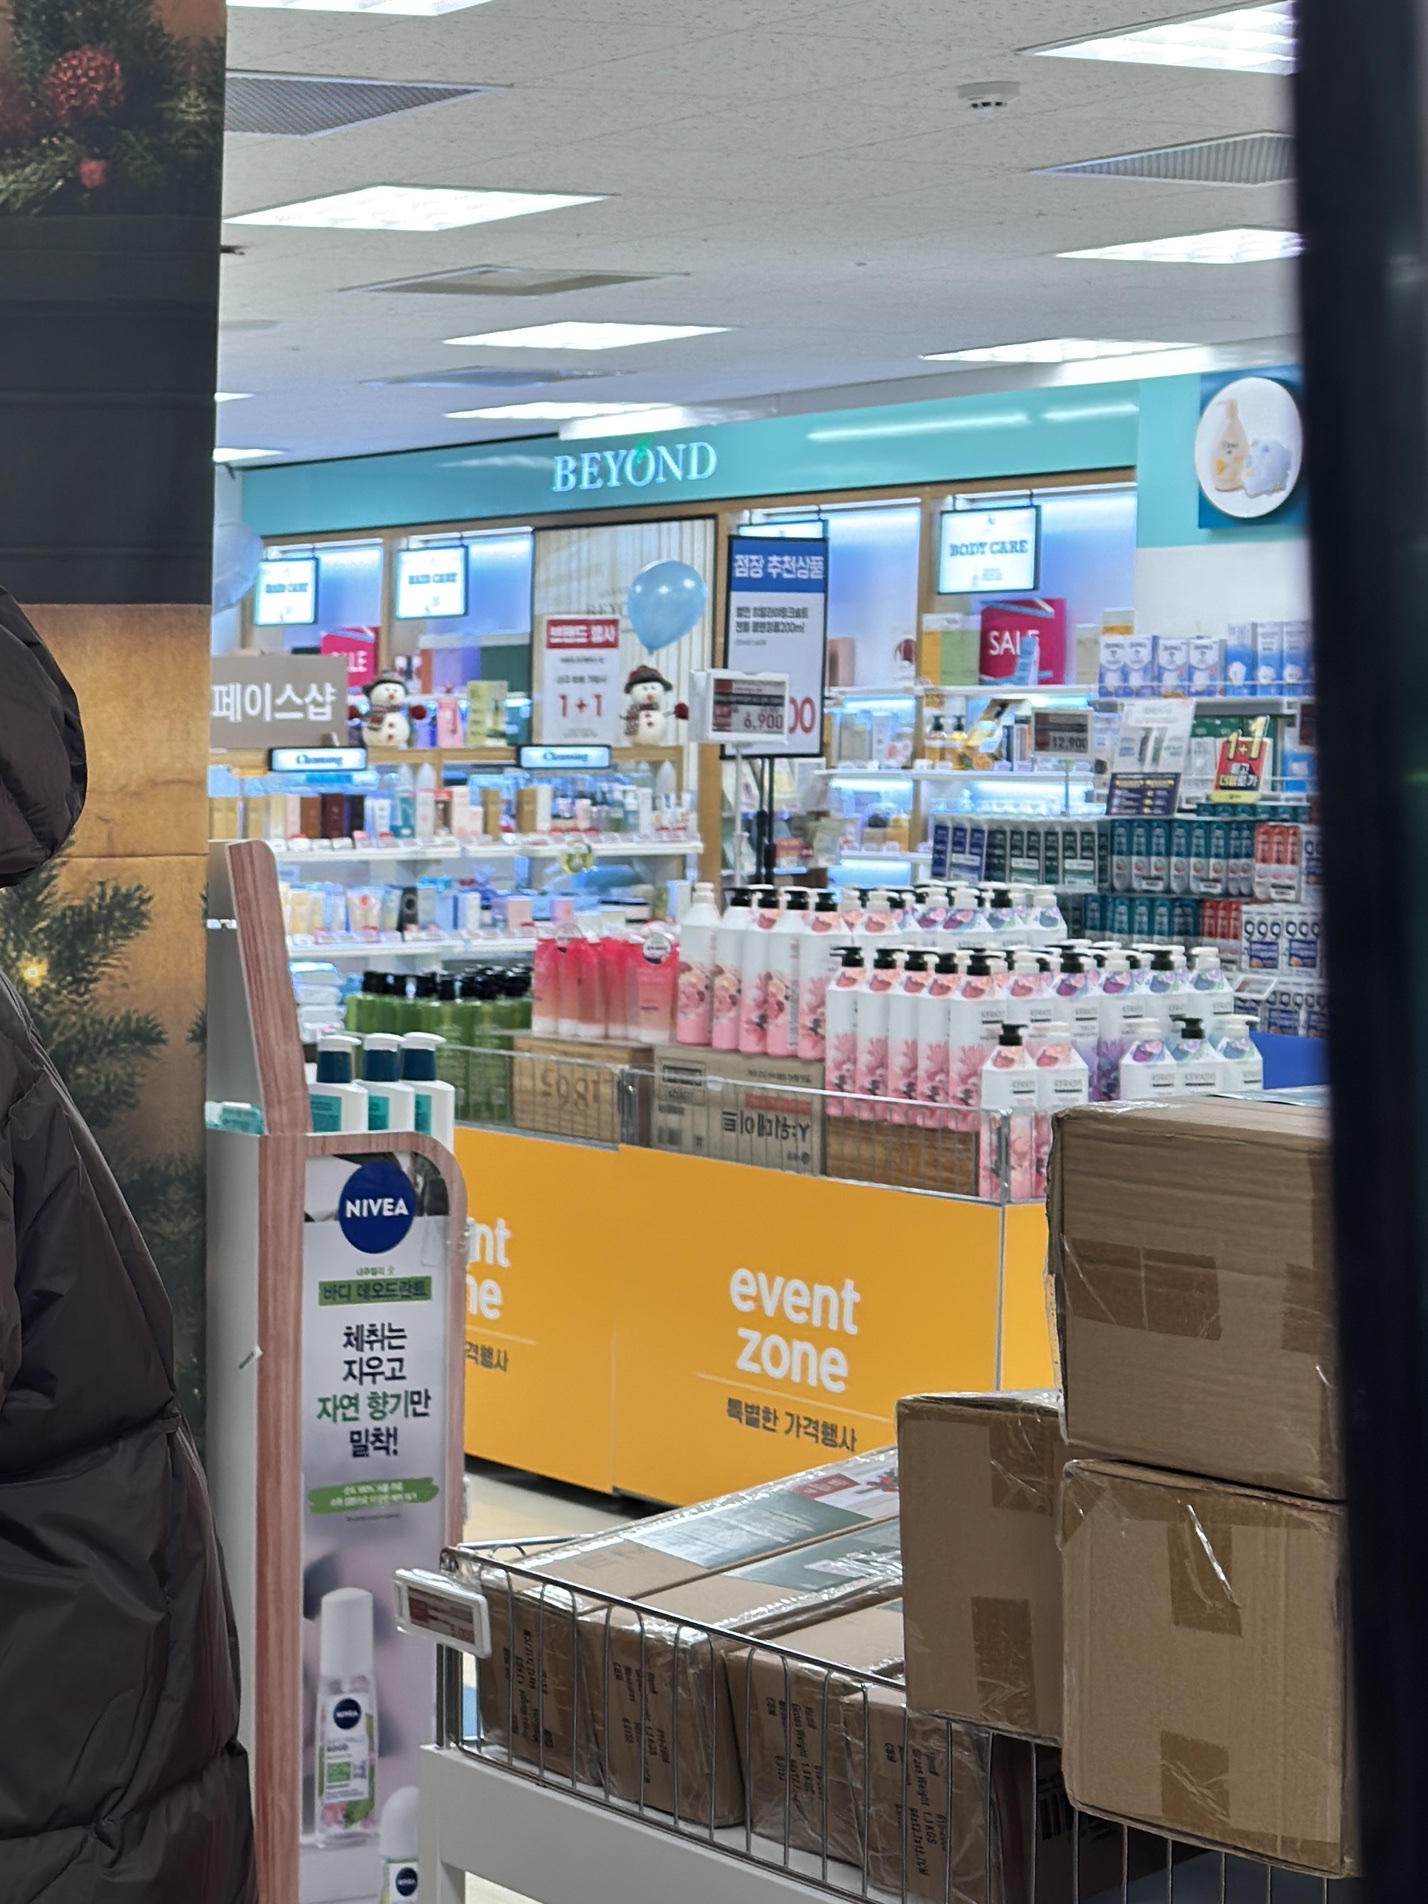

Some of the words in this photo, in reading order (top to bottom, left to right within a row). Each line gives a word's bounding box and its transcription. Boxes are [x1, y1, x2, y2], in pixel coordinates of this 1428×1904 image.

[552, 441, 717, 493] BEYOND
[949, 541, 986, 557] BODY
[989, 540, 1028, 555] CARE
[559, 693, 604, 719] 1+1
[1227, 715, 1270, 761] 1+1
[345, 1197, 410, 1220] NIVEA
[729, 1267, 861, 1336] event
[342, 1322, 408, 1353] 체취는
[342, 1355, 407, 1386] 지우고
[466, 1339, 509, 1374] 격행사
[736, 1327, 849, 1394] zone
[316, 1394, 361, 1423] 자연
[367, 1388, 432, 1422] 향기만
[349, 1426, 399, 1459] 밀착!
[783, 1411, 858, 1454] 가격행사
